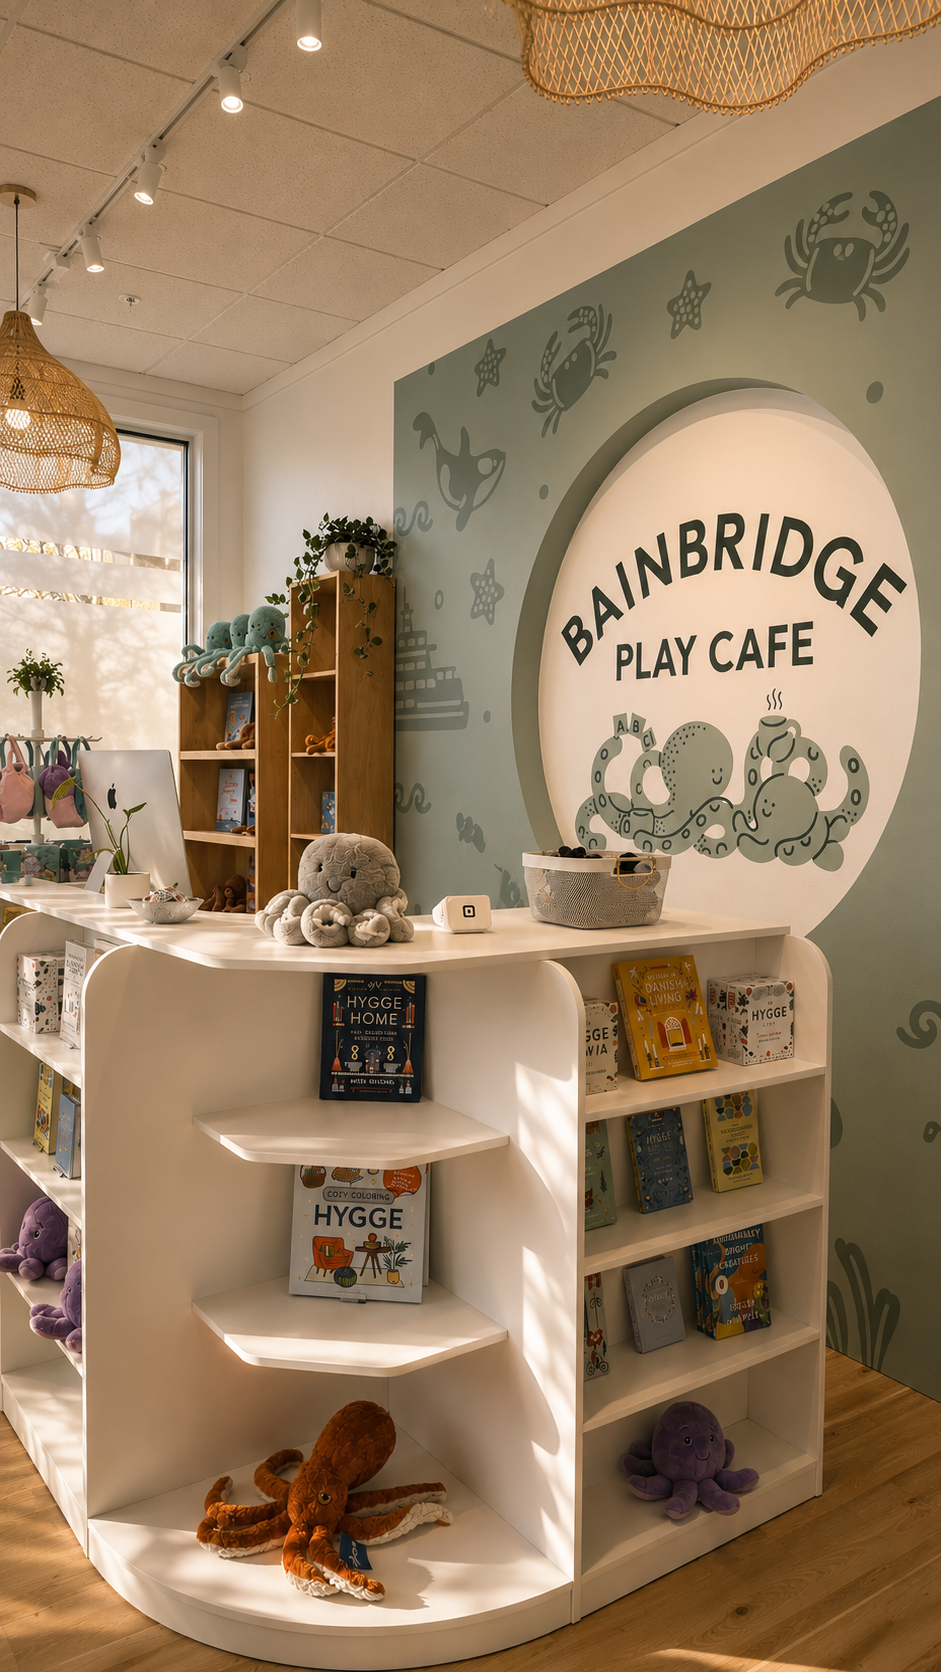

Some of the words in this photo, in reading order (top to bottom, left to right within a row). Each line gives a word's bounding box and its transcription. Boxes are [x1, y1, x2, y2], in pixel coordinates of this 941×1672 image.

[561, 512, 907, 666] BAINBRIDGE
[616, 634, 697, 681] PLAY
[709, 620, 814, 673] CAFE
[346, 995, 402, 1010] HYGGE
[350, 1012, 398, 1026] HOME
[752, 1006, 787, 1021] HYGGE
[351, 1192, 390, 1201] COLORING
[314, 1204, 403, 1230] HYGGE
